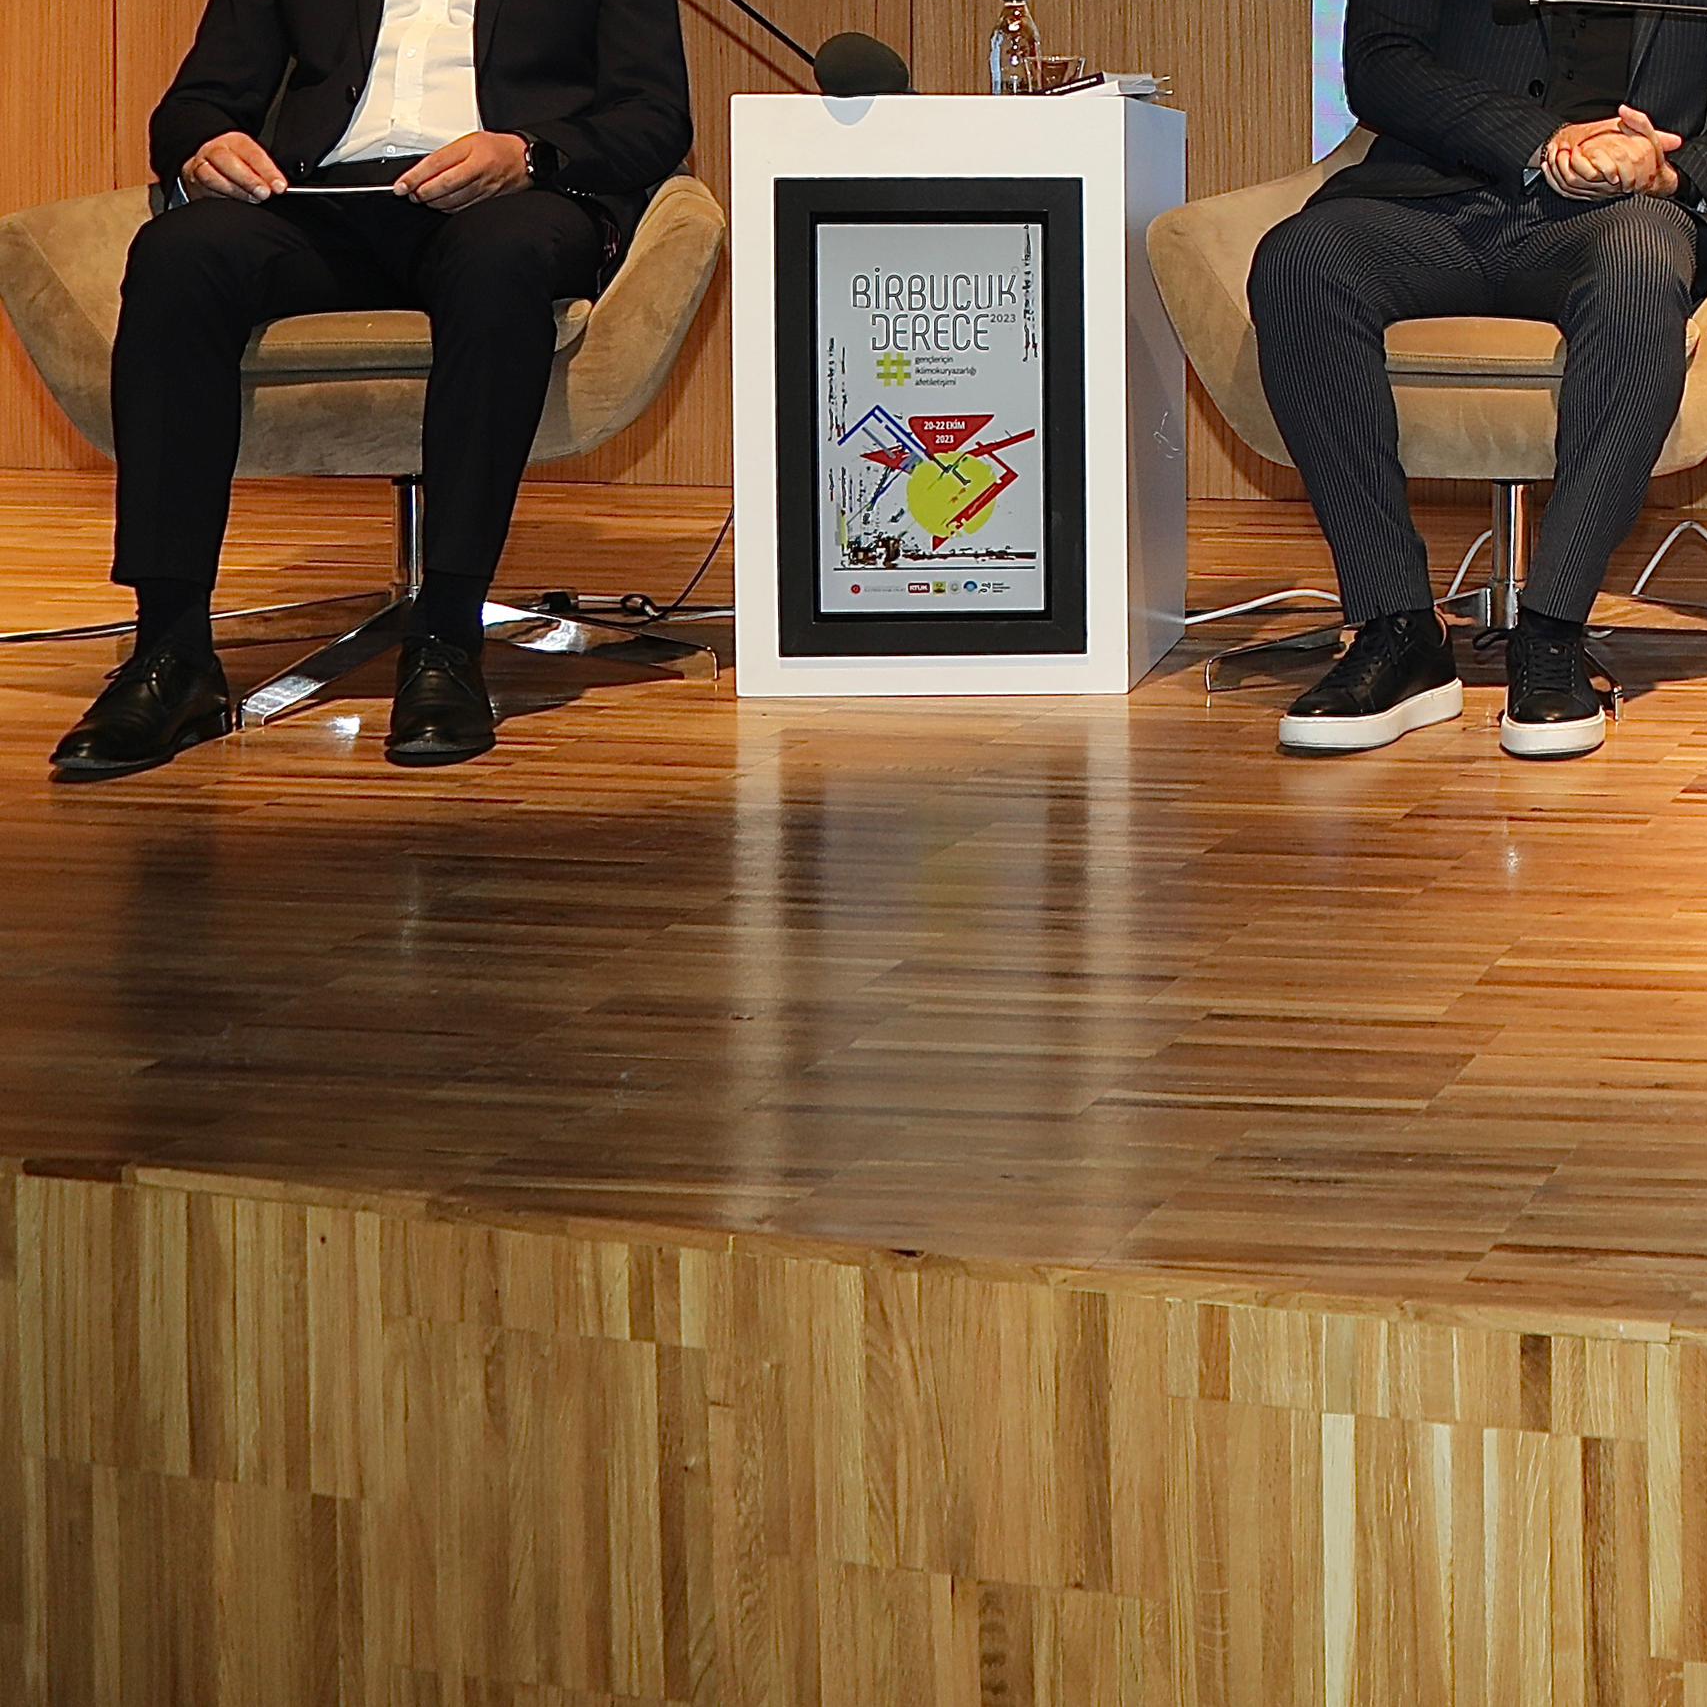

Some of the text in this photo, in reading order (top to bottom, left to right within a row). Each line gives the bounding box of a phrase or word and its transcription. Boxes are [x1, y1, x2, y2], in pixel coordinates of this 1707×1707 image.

[990, 313, 1017, 323] 2023
[923, 421, 945, 431] 20-22
[935, 434, 954, 444] 2023
